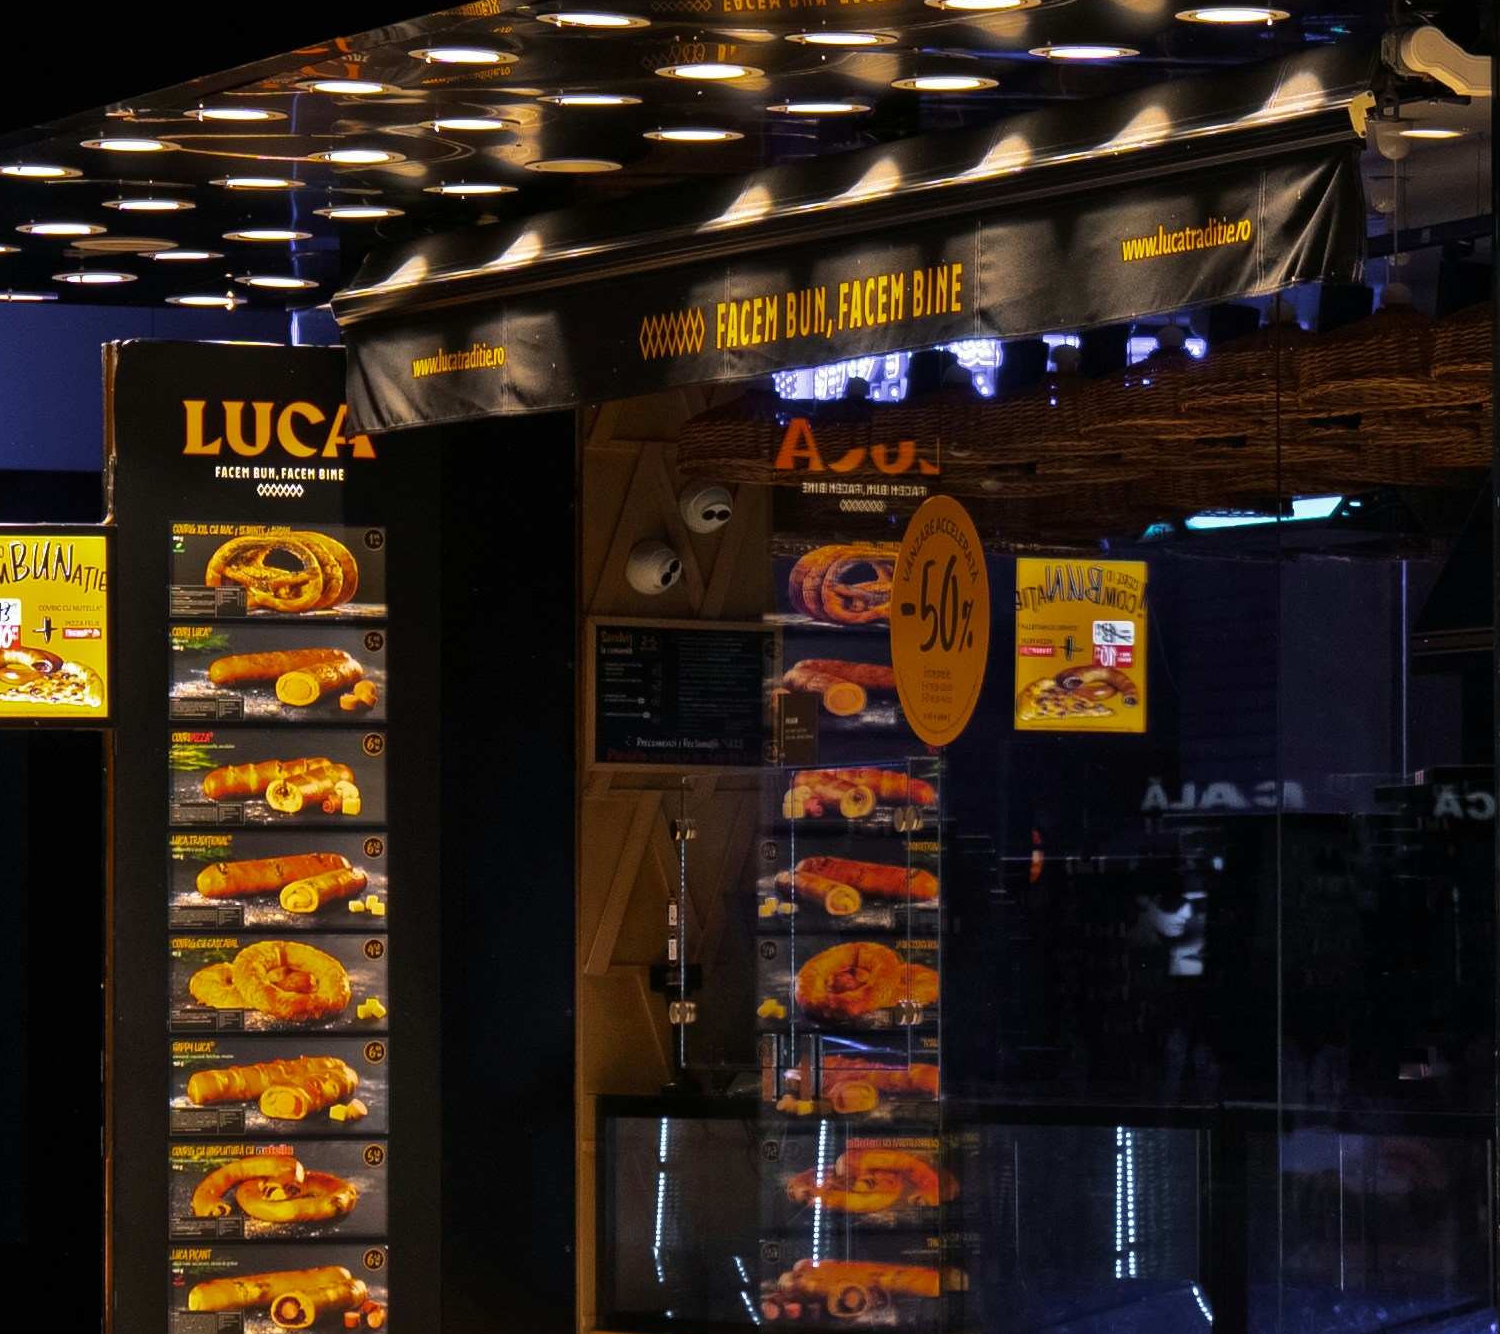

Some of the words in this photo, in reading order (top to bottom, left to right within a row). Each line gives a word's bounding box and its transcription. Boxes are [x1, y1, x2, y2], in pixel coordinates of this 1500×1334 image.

[1120, 218, 1253, 264] www.lucatraditie.ro
[716, 295, 780, 349] FACEM
[786, 286, 835, 342] BUN,
[837, 272, 905, 330] FACEM
[912, 263, 963, 317] BINE
[183, 400, 377, 459] LUCA
[215, 466, 250, 479] FACEM
[281, 468, 316, 480] FACEM
[318, 469, 345, 481] BINE
